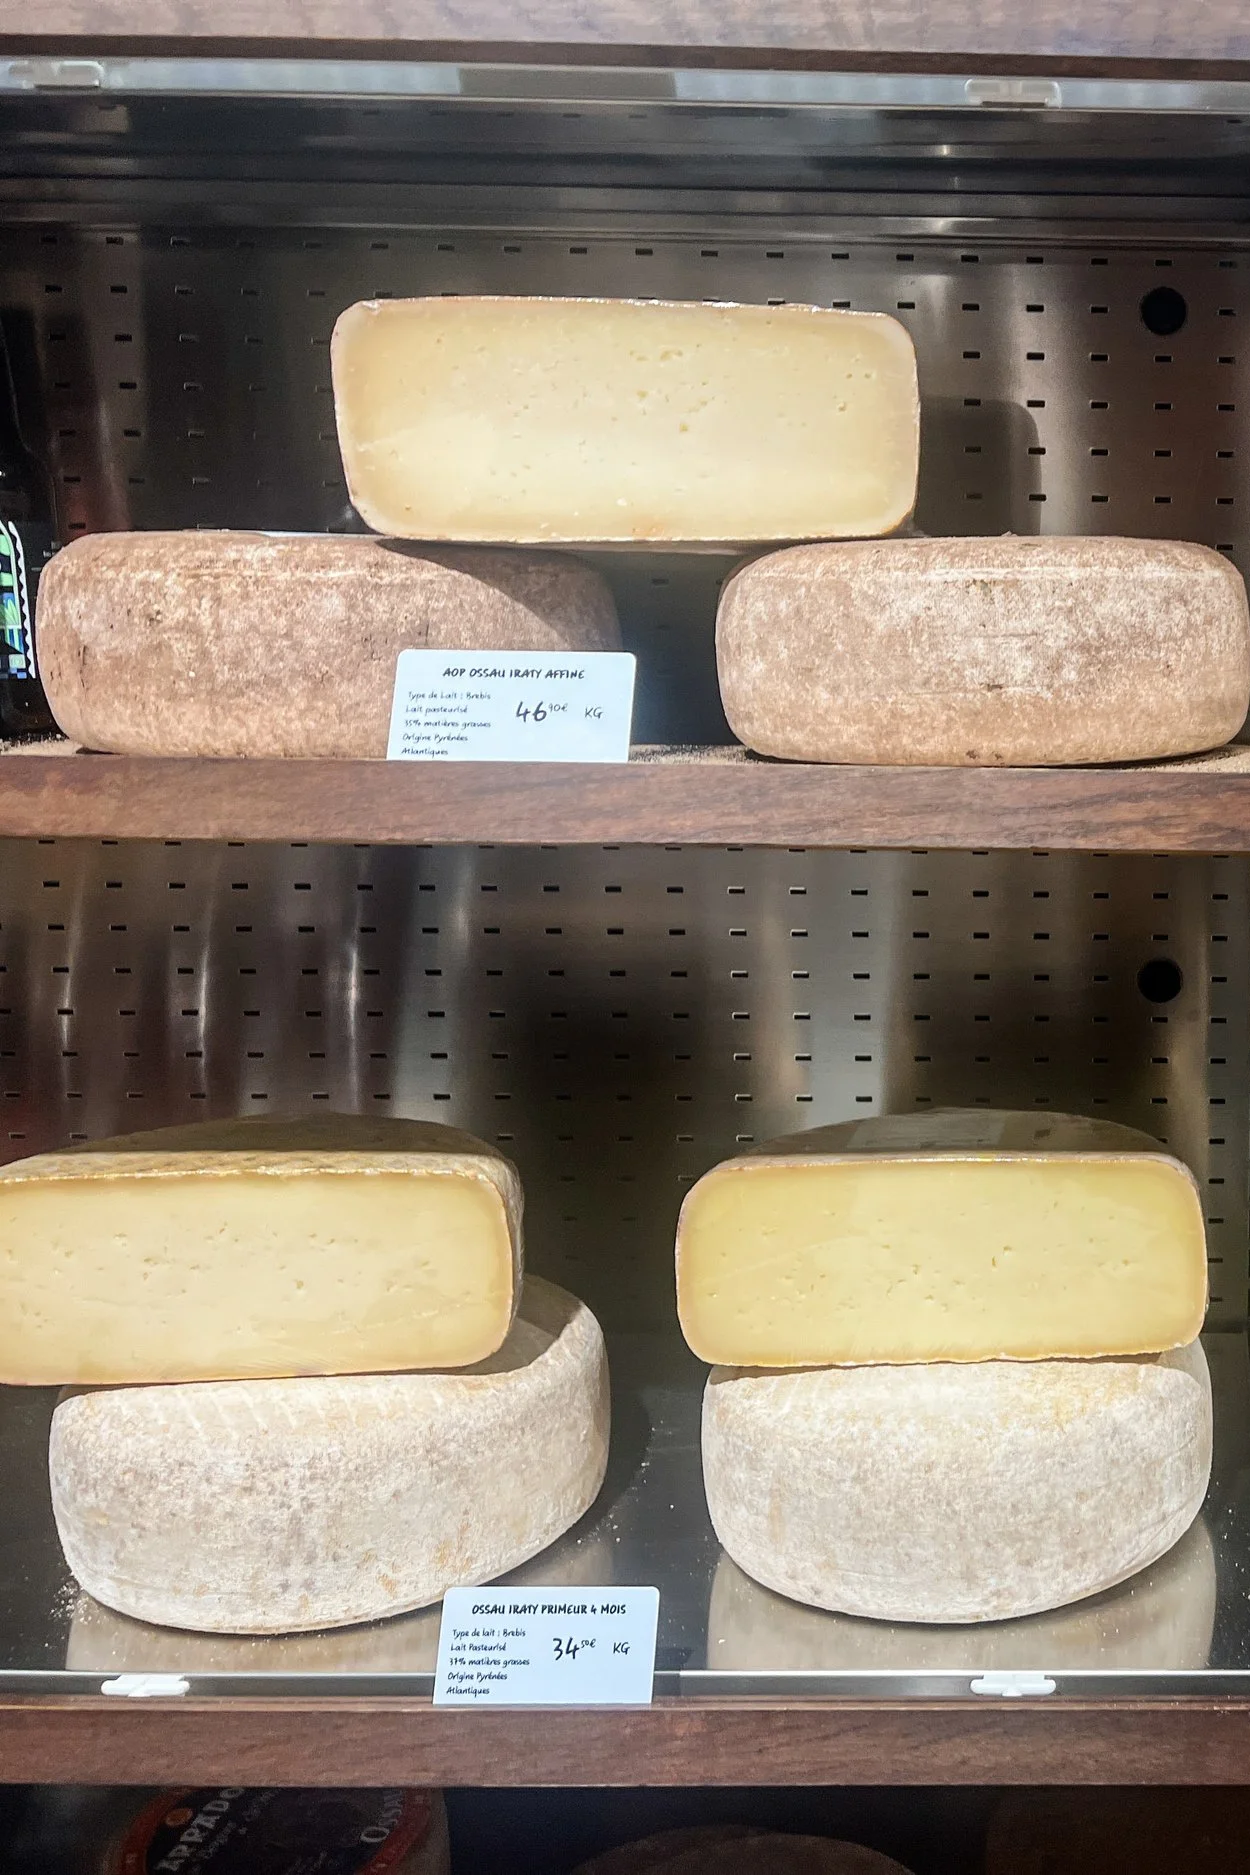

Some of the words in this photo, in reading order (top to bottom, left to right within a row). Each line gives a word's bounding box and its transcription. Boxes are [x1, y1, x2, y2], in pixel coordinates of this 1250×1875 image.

[443, 668, 466, 677] AOP
[469, 669, 505, 677] OSSAU
[510, 669, 542, 678] IRATY
[545, 670, 584, 679] AFFINE
[409, 692, 425, 702] Type
[585, 707, 603, 719] KG
[462, 722, 491, 730] grasses
[403, 733, 431, 743] Origine
[401, 748, 448, 758] Atlantiques
[472, 1604, 505, 1614] OSSAU
[509, 1604, 538, 1614] IRATY
[541, 1604, 587, 1614] PRIMEUR
[591, 1605, 597, 1614] 4
[601, 1604, 626, 1614] MOIS
[453, 1629, 469, 1640] Type
[471, 1628, 480, 1636] de
[482, 1628, 495, 1636] lait
[503, 1628, 525, 1637] Brebis
[613, 1642, 630, 1655] KG
[450, 1657, 466, 1665] 37%
[502, 1659, 530, 1668] grasses
[448, 1672, 474, 1682] Origine
[446, 1686, 489, 1698] Atlantiques
